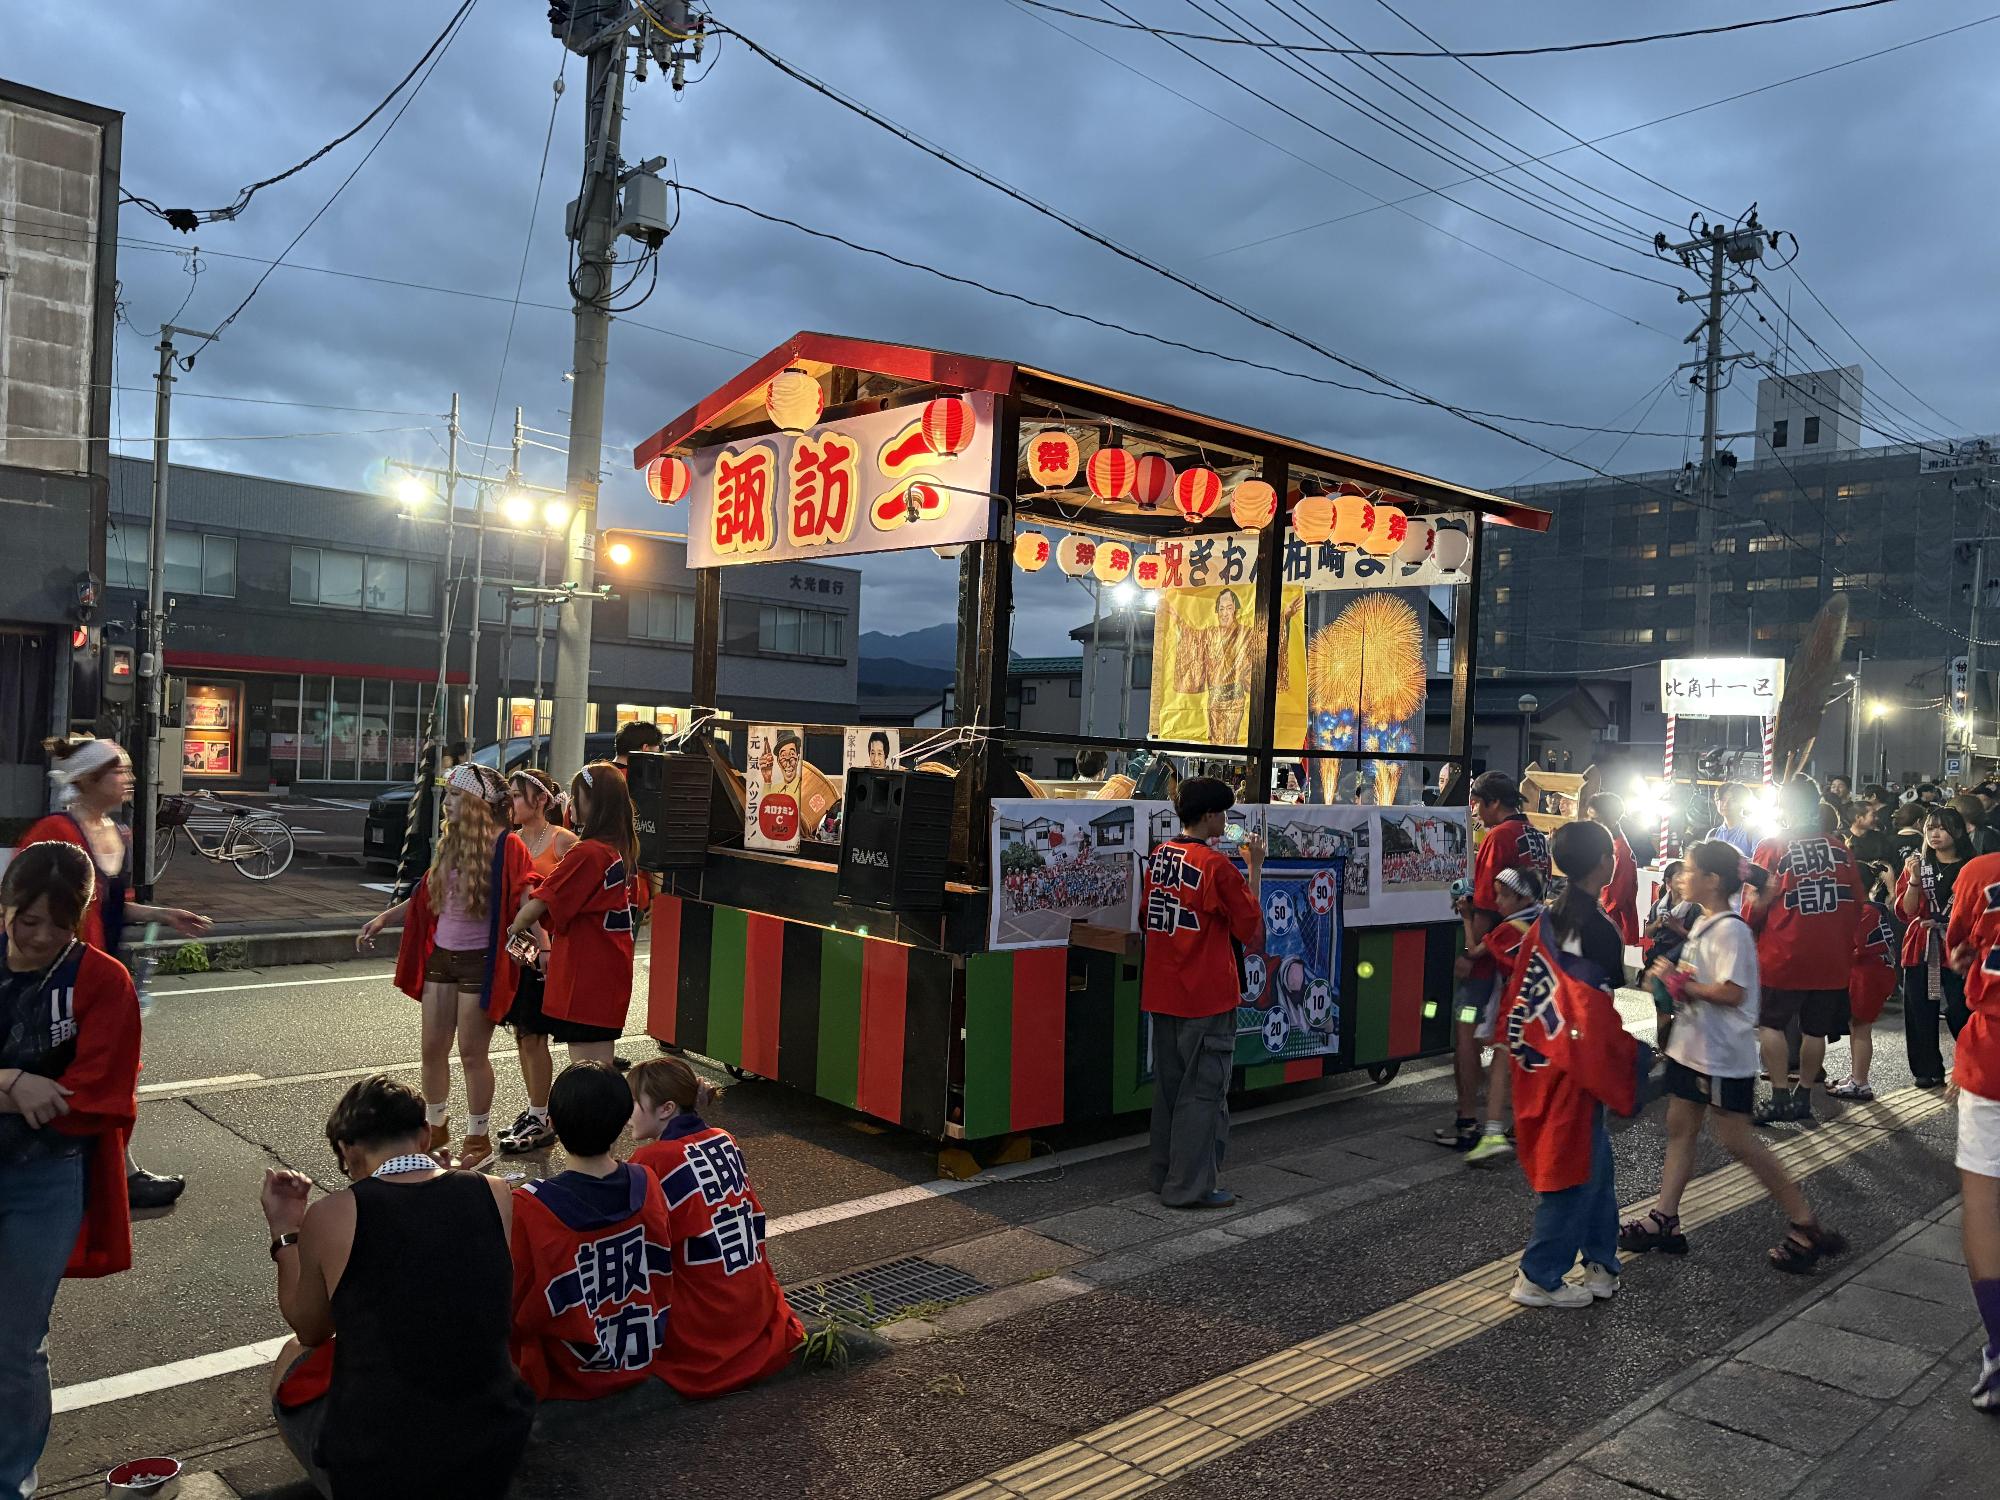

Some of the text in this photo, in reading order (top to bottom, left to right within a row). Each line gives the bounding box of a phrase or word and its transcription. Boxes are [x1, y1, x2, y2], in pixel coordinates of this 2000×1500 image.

[1038, 441, 1070, 472] 祭
[1110, 549, 1130, 571] 祭
[1138, 561, 1158, 580] 祭
[1665, 677, 1774, 698] 比角十一区
[763, 805, 795, 816] オロナミン
[775, 815, 784, 825] C
[851, 848, 889, 867] RAMSA
[1787, 837, 1838, 915] 諏訪
[1147, 844, 1187, 937] 諏訪
[1316, 885, 1328, 900] 90
[1274, 905, 1286, 921] 50
[1313, 994, 1325, 1011] 10
[1270, 1021, 1282, 1037] 20
[684, 1133, 762, 1277] 諏訪
[575, 1224, 652, 1372] 諏訪
